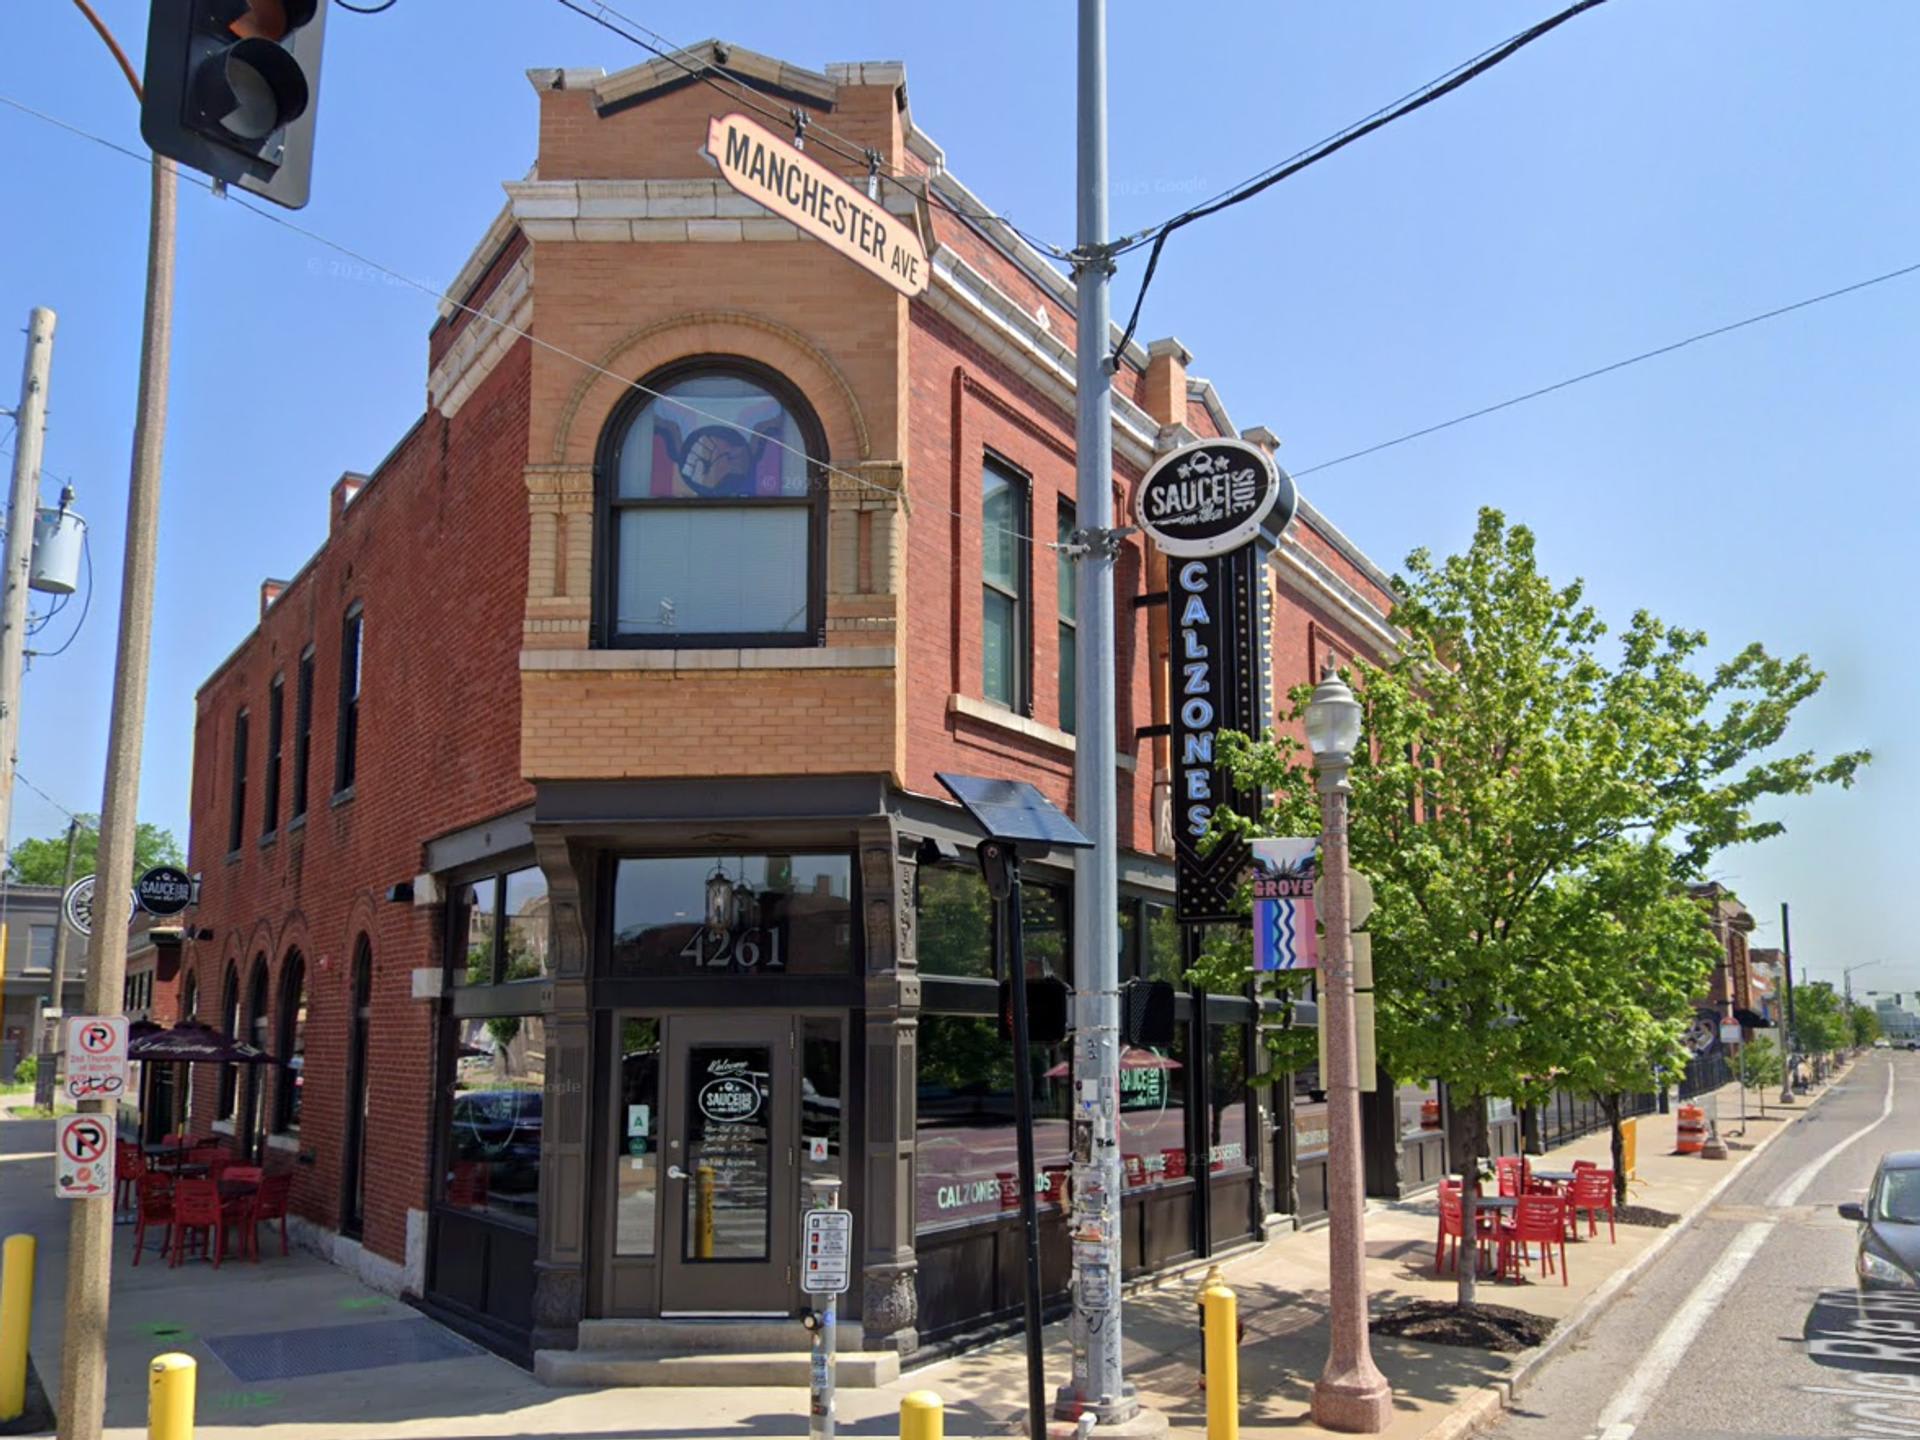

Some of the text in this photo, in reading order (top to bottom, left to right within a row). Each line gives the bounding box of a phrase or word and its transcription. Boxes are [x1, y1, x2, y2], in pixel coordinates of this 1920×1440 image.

[725, 125, 919, 286] MANCHESTER AVE
[1151, 474, 1225, 516] SAUCE
[1231, 468, 1256, 514] SIDE
[1178, 560, 1215, 836] CALZONES
[1253, 880, 1314, 897] GROVE
[679, 925, 785, 968] 4261
[937, 1179, 1002, 1210] CALZONES
